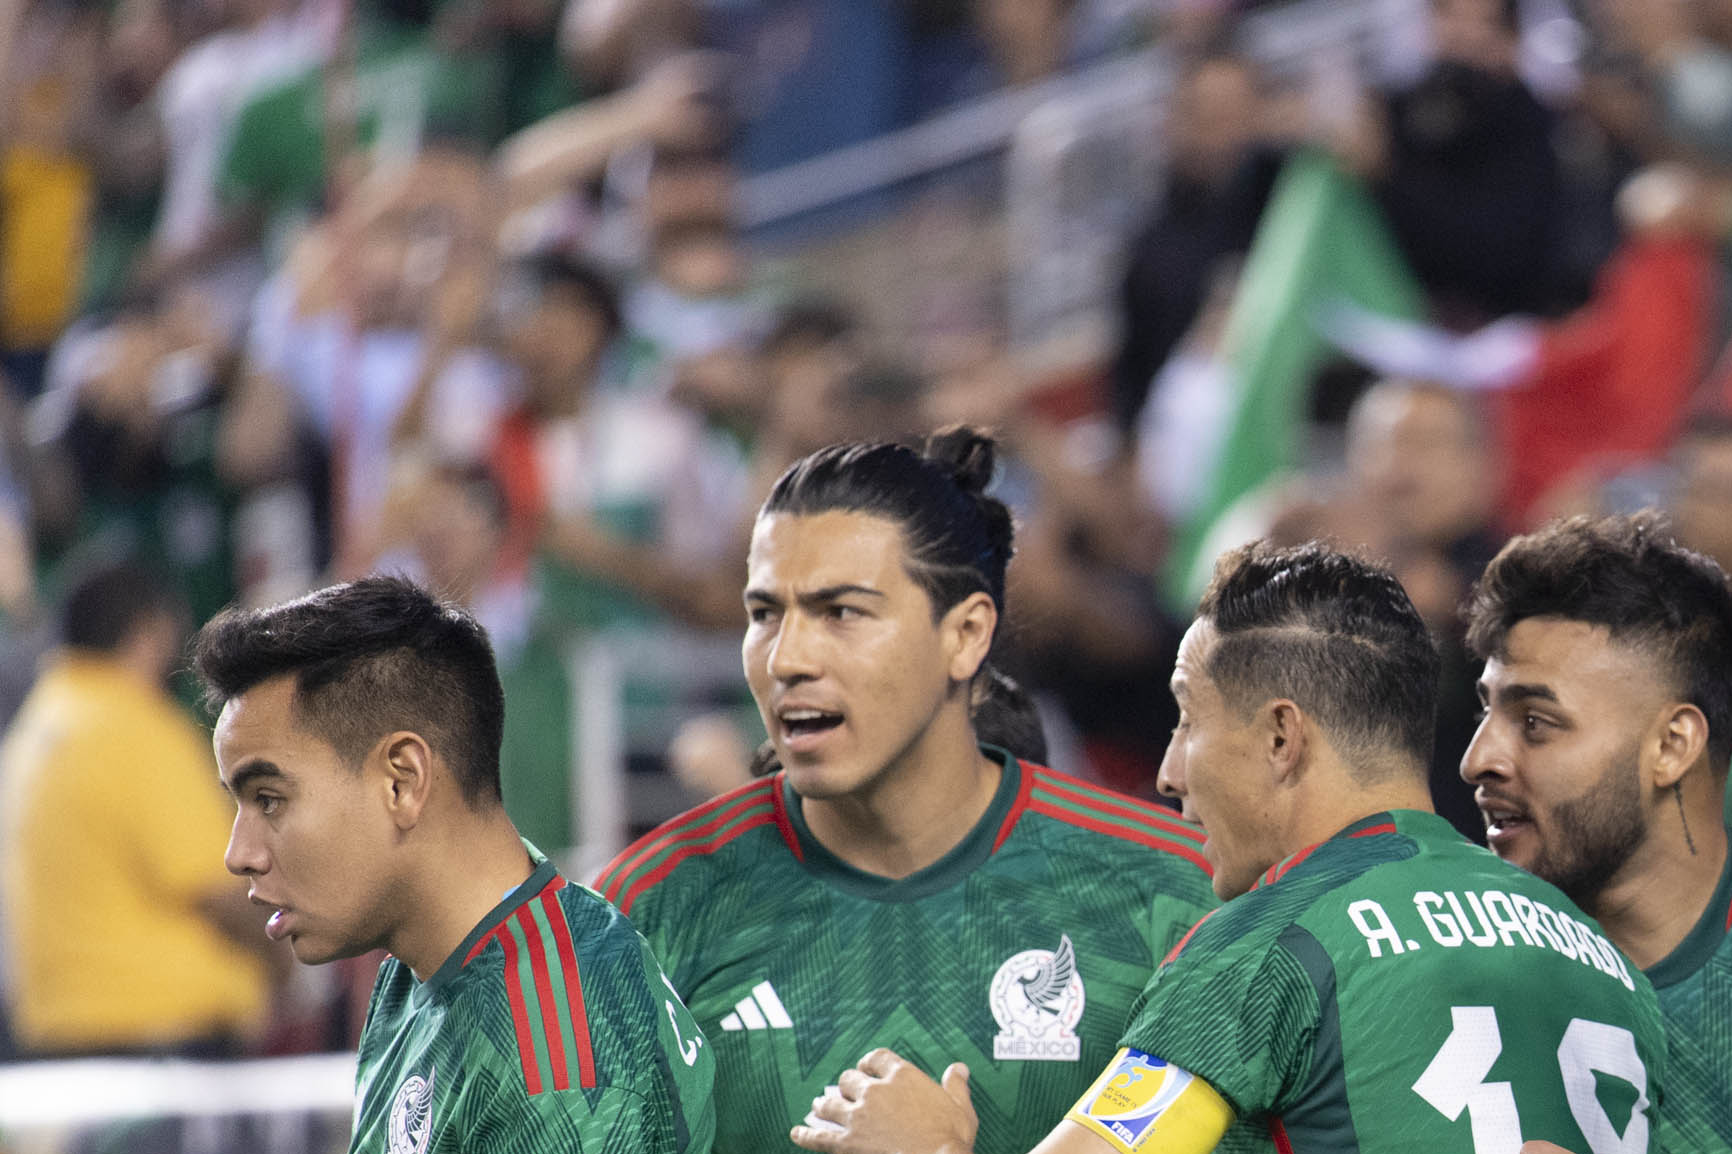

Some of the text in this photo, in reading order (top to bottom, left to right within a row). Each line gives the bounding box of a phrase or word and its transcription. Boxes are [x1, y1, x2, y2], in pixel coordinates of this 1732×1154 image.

[1347, 899, 1421, 957] A.
[998, 1036, 1076, 1056] MÉXICO
[1111, 1121, 1134, 1143] FIFA
